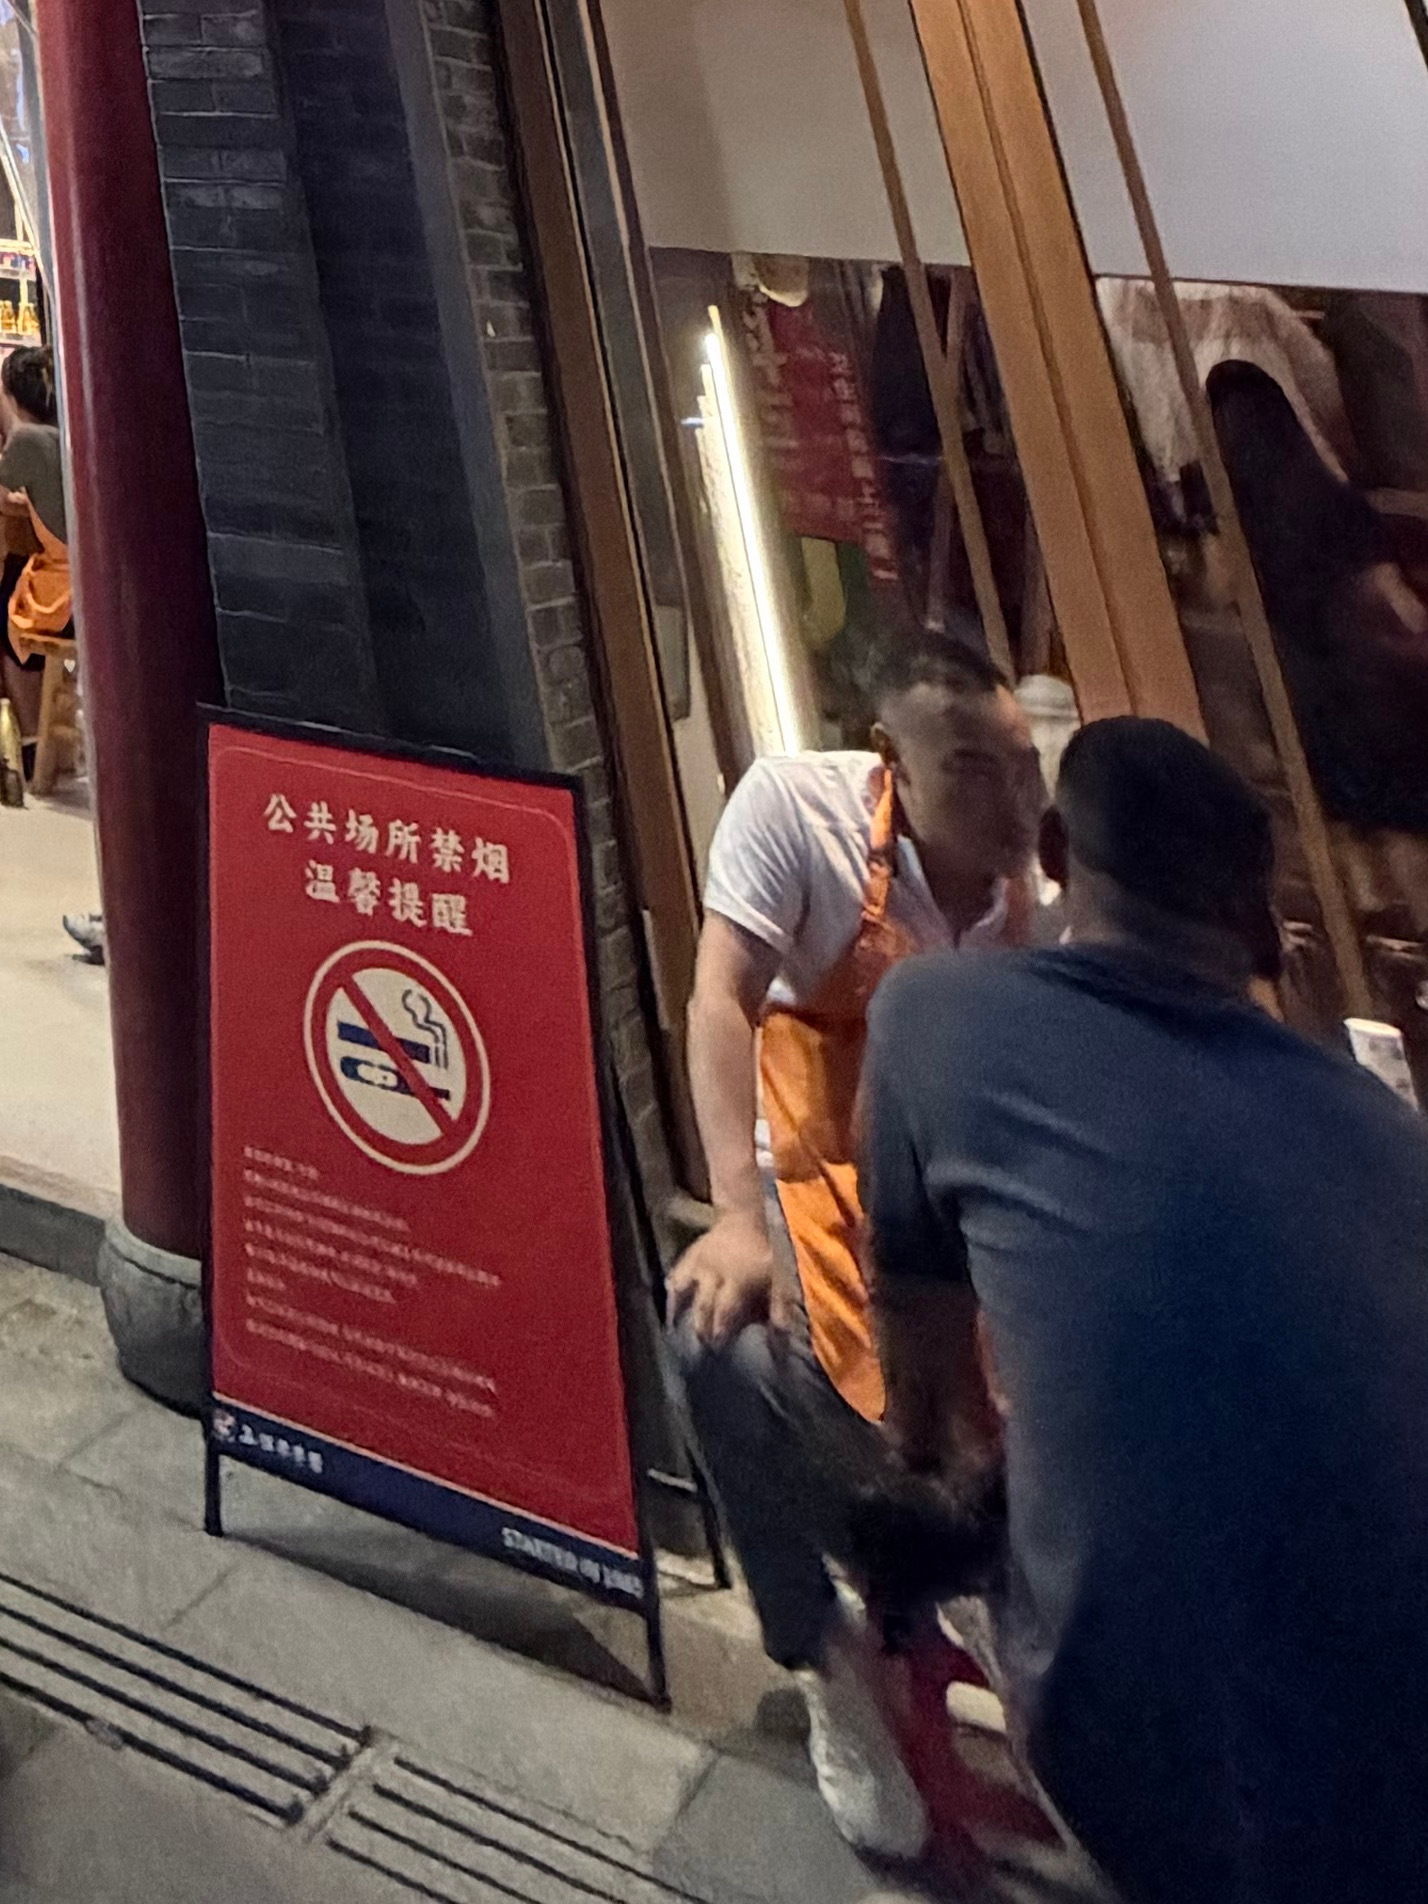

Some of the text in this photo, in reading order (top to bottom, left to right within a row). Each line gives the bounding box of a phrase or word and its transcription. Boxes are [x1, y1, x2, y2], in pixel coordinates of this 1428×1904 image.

[263, 793, 510, 884] 公共场所禁烟
[304, 859, 473, 936] 温馨提醒
